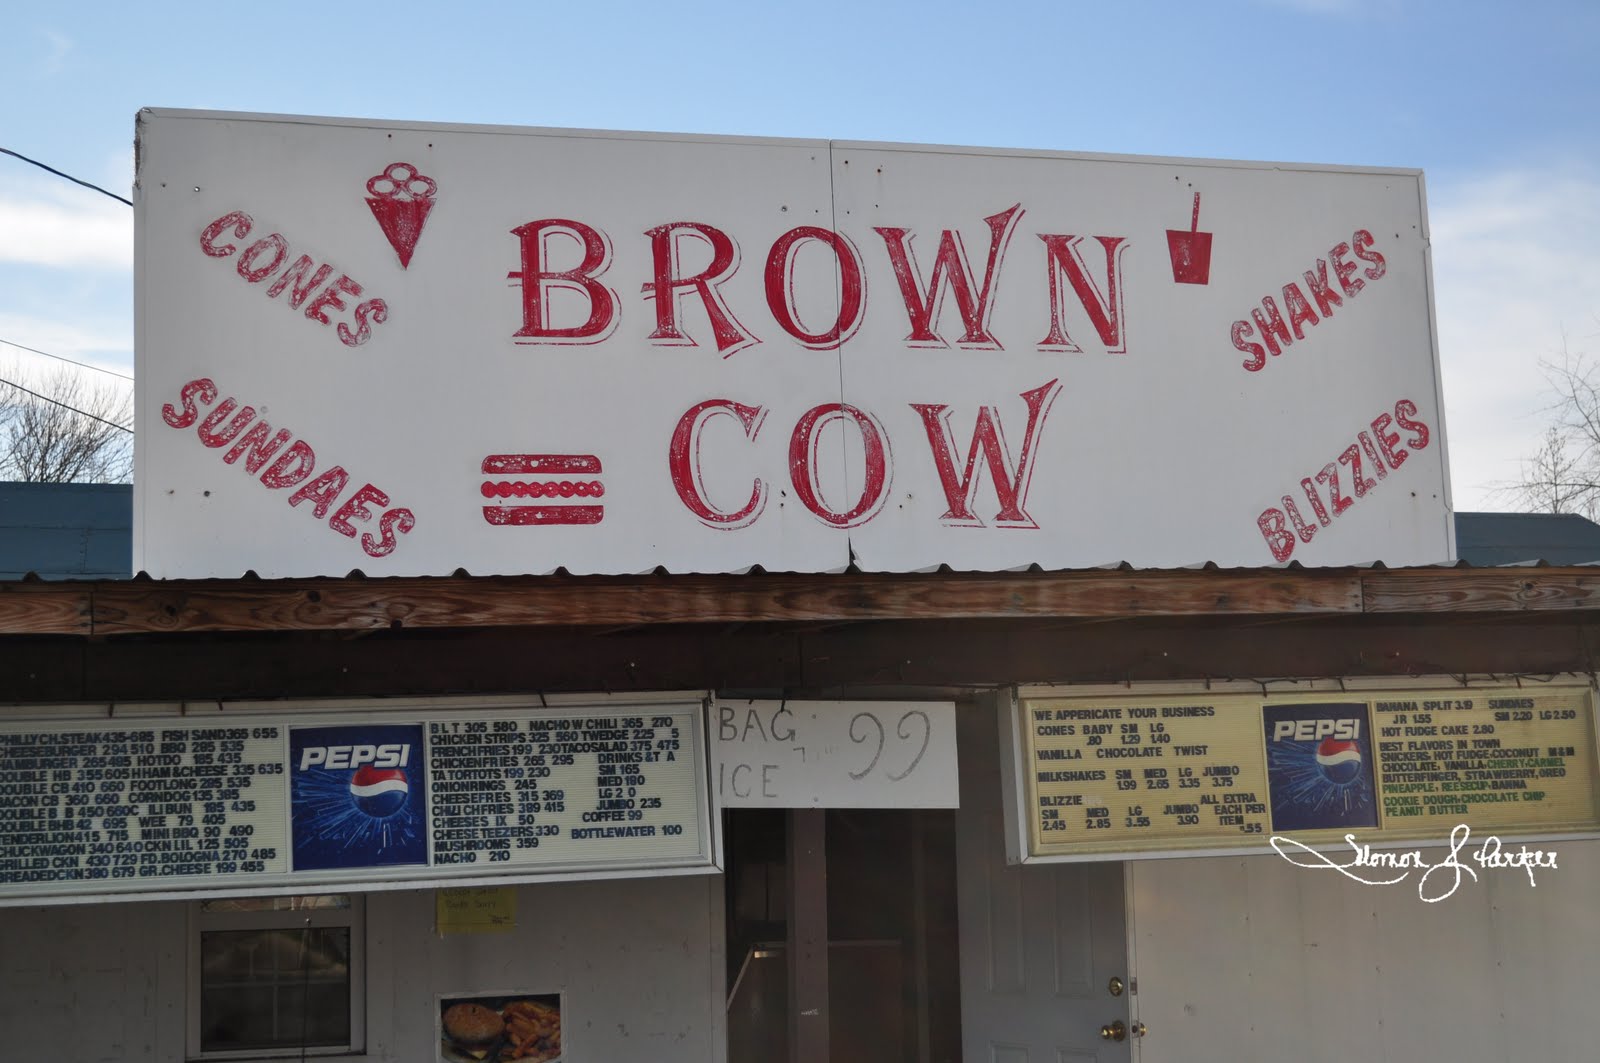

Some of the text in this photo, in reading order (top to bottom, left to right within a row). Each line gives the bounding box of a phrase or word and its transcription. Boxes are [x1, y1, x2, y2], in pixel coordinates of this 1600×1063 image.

[200, 210, 388, 347] CONES
[507, 202, 1130, 359] BROWN
[1230, 228, 1387, 372] SHAKES
[162, 377, 416, 558] SUNDAES
[669, 378, 1063, 531] COW
[1256, 399, 1430, 562] BLIZZIES
[300, 743, 411, 772] PEPSI
[719, 706, 796, 742] BAG
[719, 763, 780, 798] ICE
[1273, 718, 1361, 742] PEPSI
